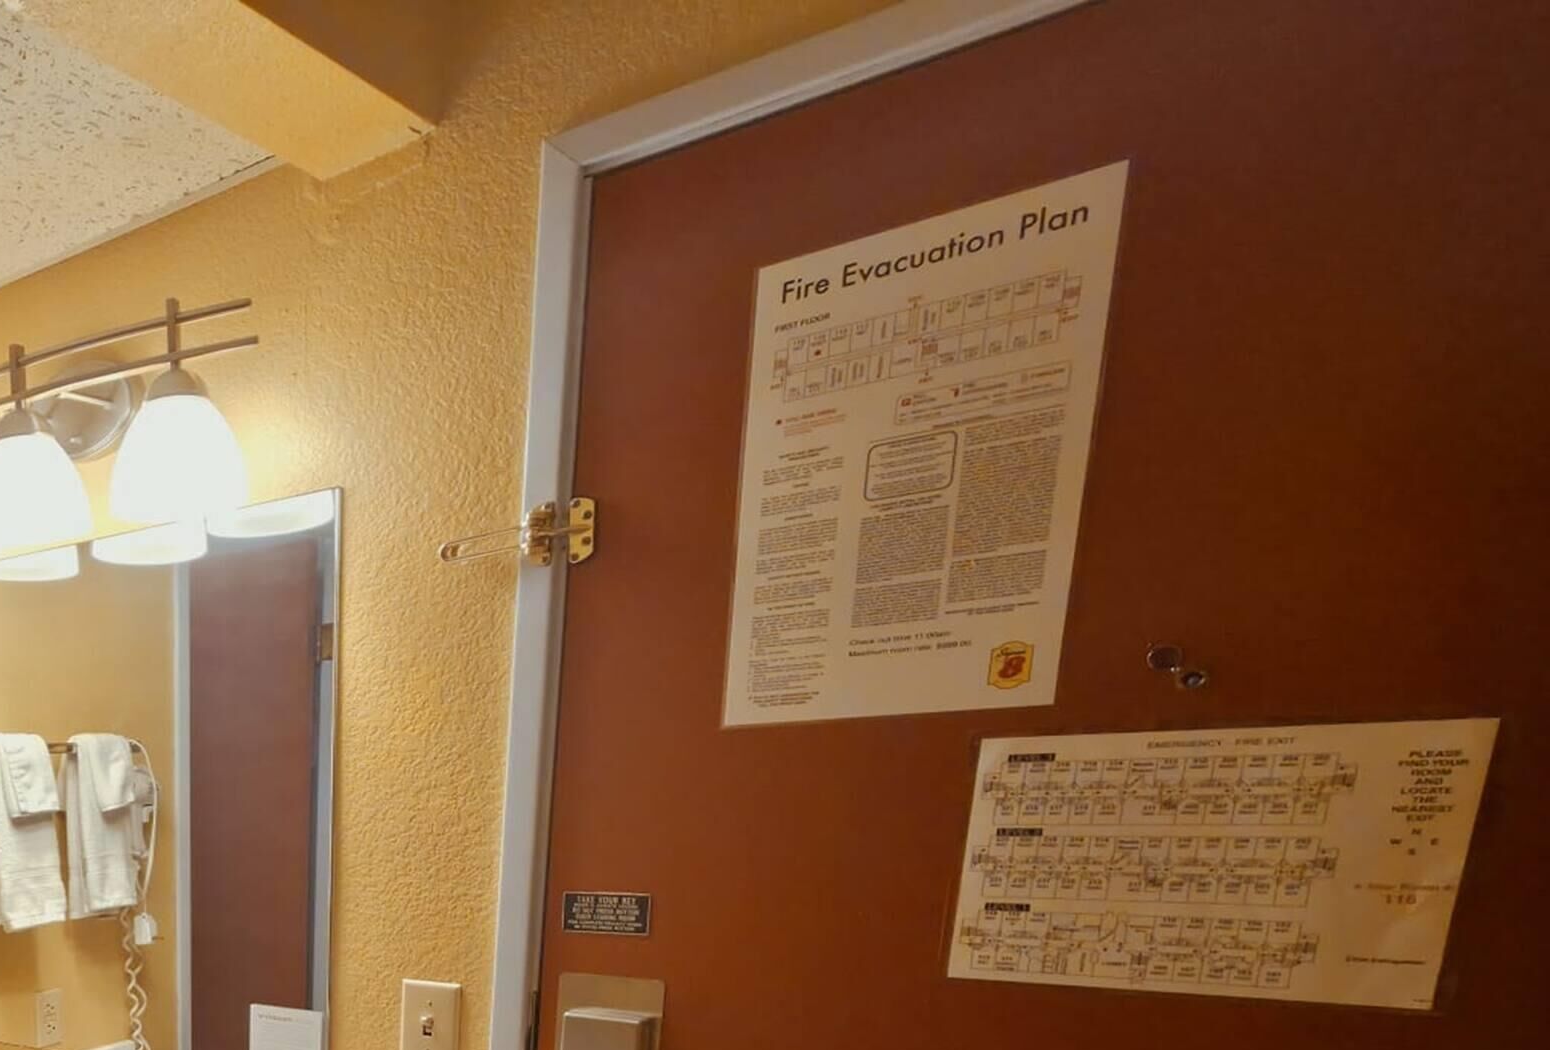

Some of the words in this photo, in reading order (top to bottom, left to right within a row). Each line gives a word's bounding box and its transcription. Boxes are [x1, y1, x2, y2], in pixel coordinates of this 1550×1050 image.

[780, 277, 829, 305] Fire
[841, 228, 1004, 288] Evacuation
[1018, 203, 1089, 240] Plan
[774, 321, 798, 333] FIRST
[799, 312, 831, 327] FLOOR
[1146, 739, 1221, 749] EMERGENCY
[1234, 738, 1262, 746] FIRE
[1266, 736, 1296, 745] EXIT
[1408, 749, 1464, 758] PLEASE
[1398, 759, 1429, 767] FIND
[1431, 758, 1470, 767] YOUR
[1410, 768, 1453, 776] ROOM
[1414, 777, 1444, 785] AND
[1399, 787, 1454, 795] LOCATE
[1412, 796, 1439, 804] THE
[1391, 805, 1456, 813] NEAREST
[1405, 814, 1436, 822] EXIT
[577, 895, 594, 903] TAKE
[598, 896, 619, 904] YOUR
[621, 896, 636, 905] KEY
